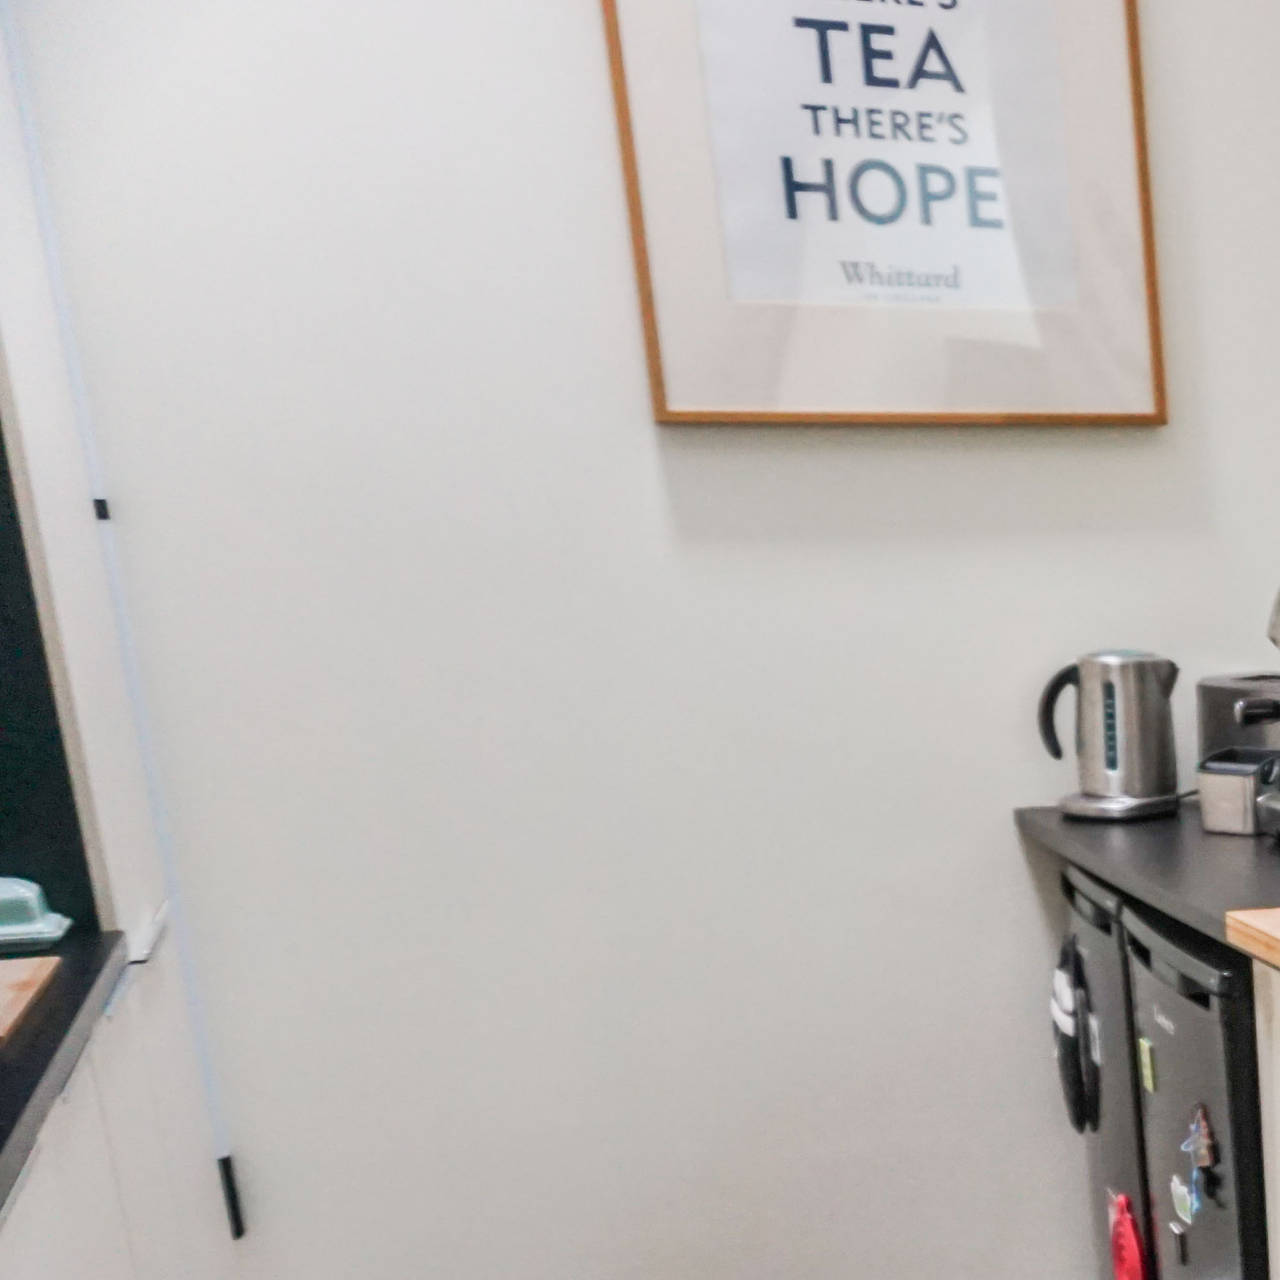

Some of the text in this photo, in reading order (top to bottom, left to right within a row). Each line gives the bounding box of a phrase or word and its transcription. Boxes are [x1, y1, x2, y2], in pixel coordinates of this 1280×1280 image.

[793, 17, 966, 93] TEA
[801, 104, 969, 145] THERE'S
[780, 155, 1004, 229] HOPE
